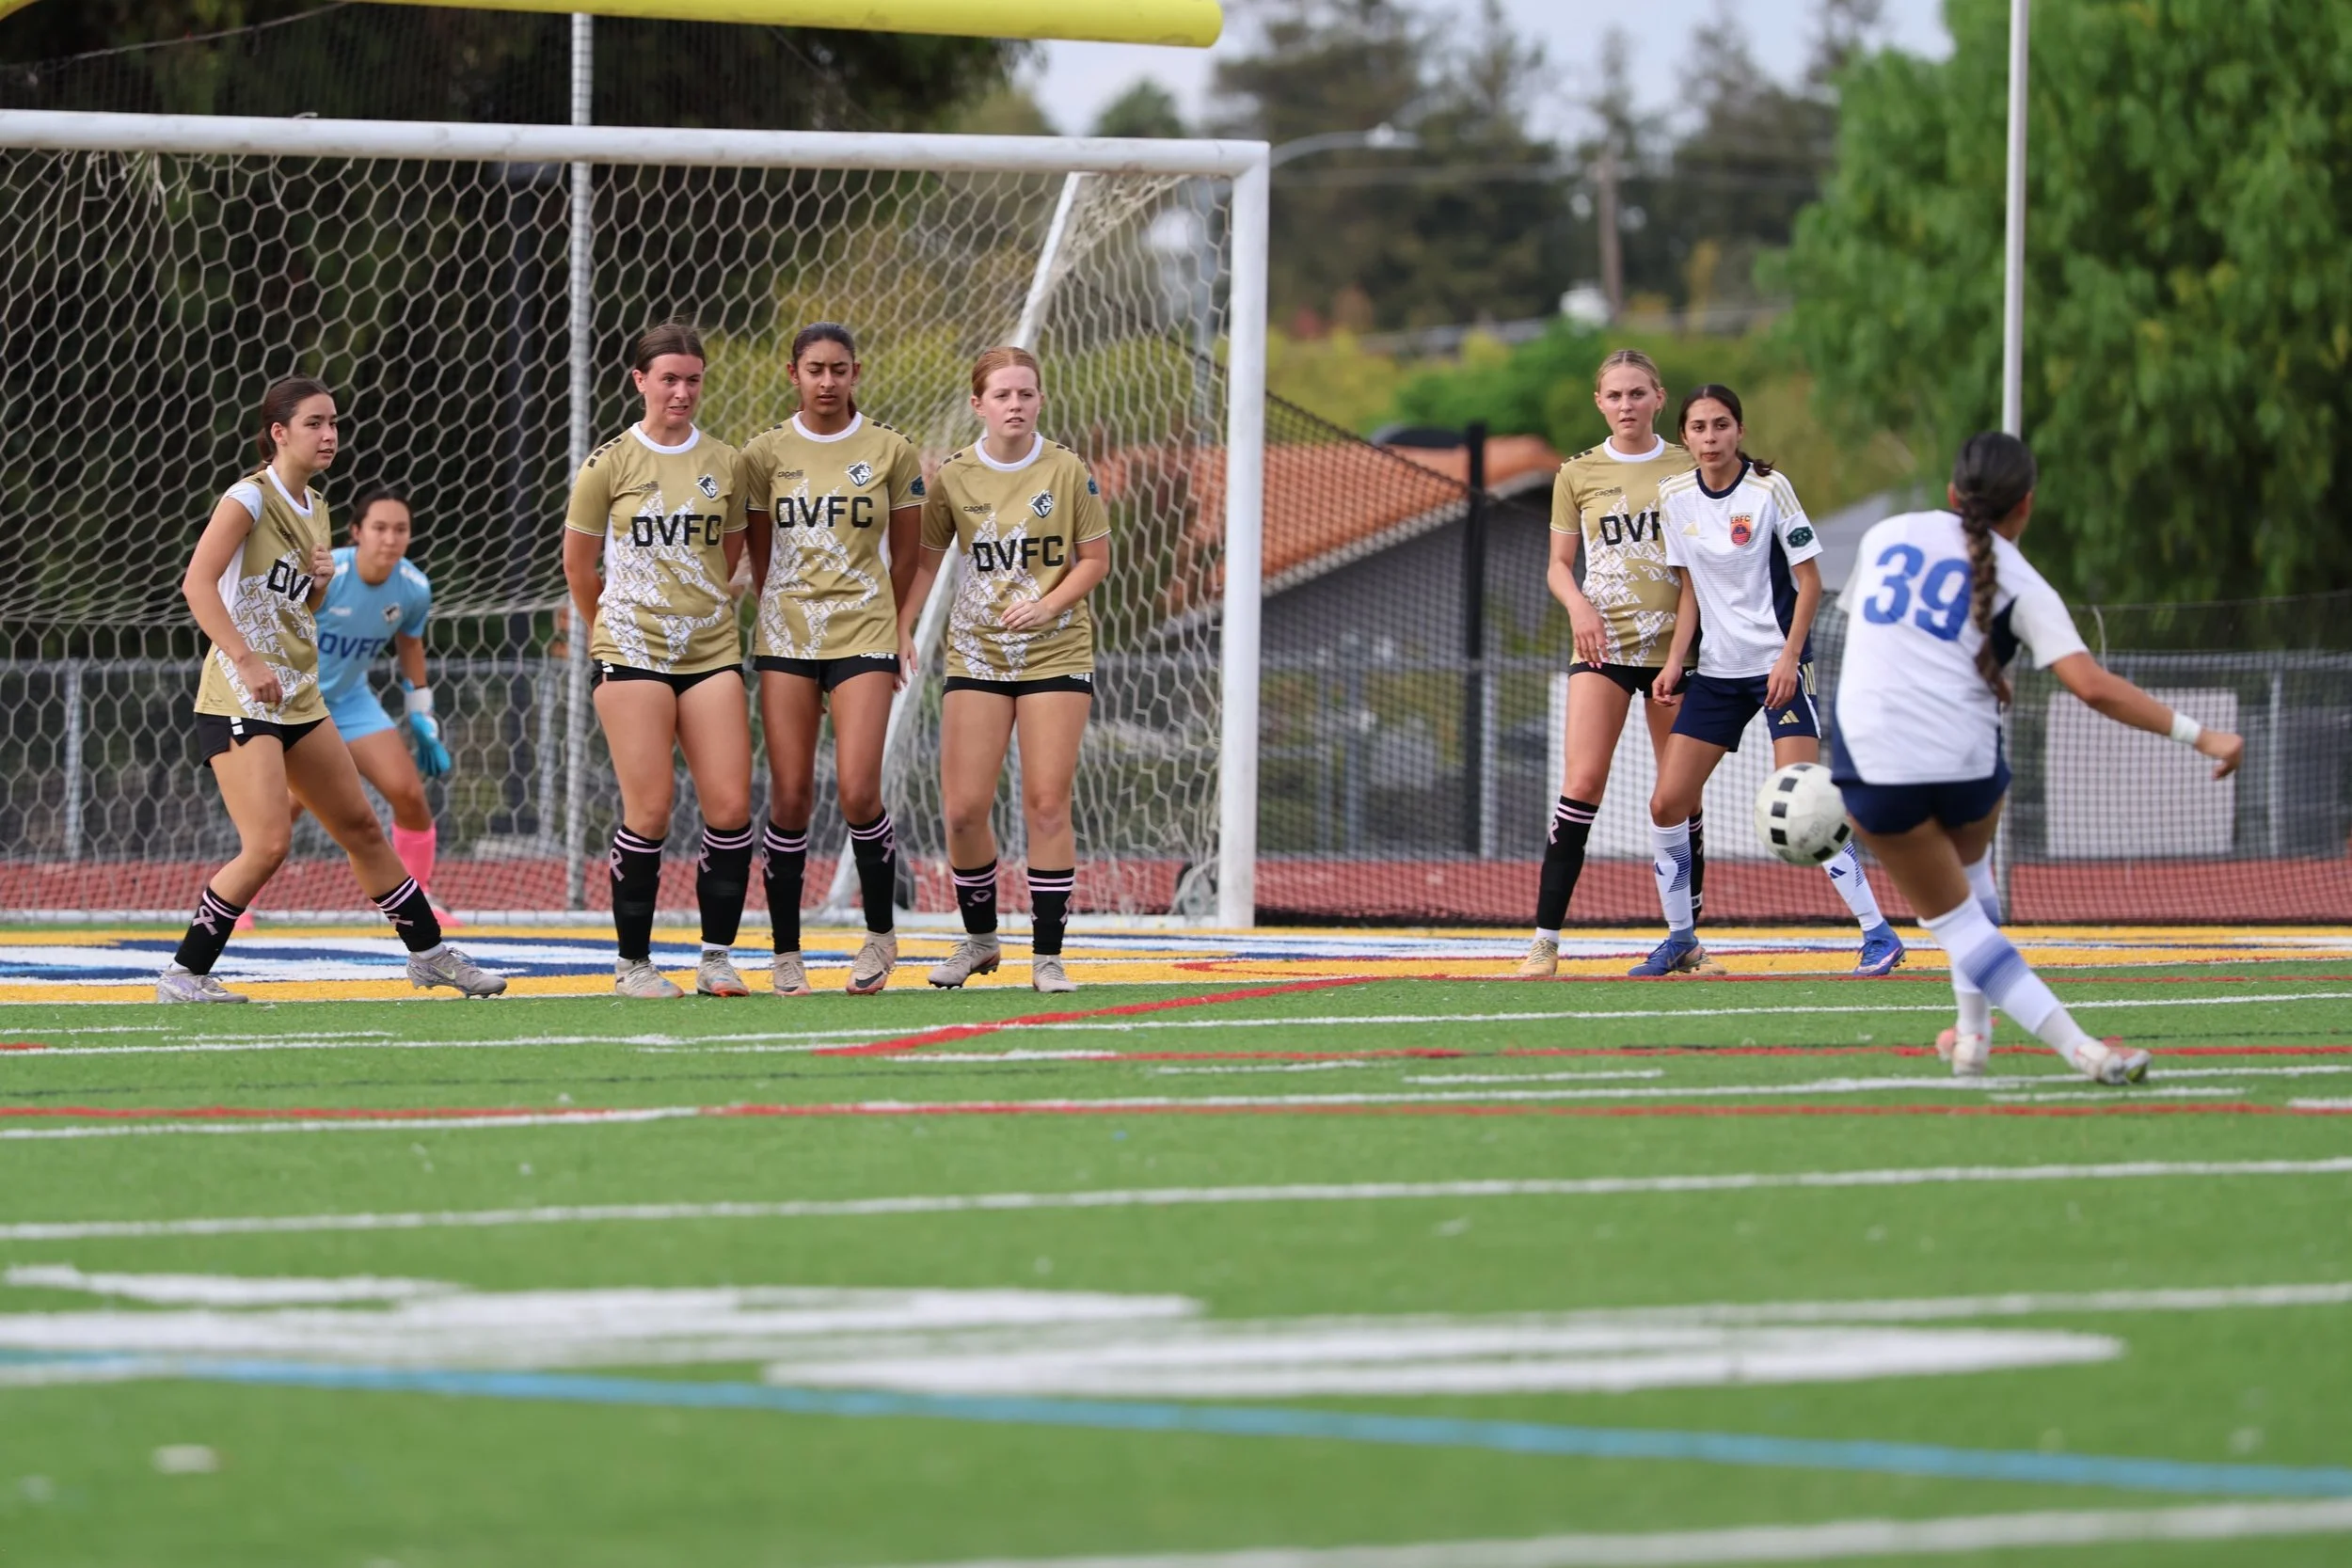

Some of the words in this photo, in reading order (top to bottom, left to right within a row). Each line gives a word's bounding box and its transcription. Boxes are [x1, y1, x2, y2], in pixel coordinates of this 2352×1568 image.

[776, 497, 873, 529] DVFC
[631, 515, 722, 547] DVFC
[973, 535, 1064, 572] DVFC
[1864, 543, 1973, 641] 39
